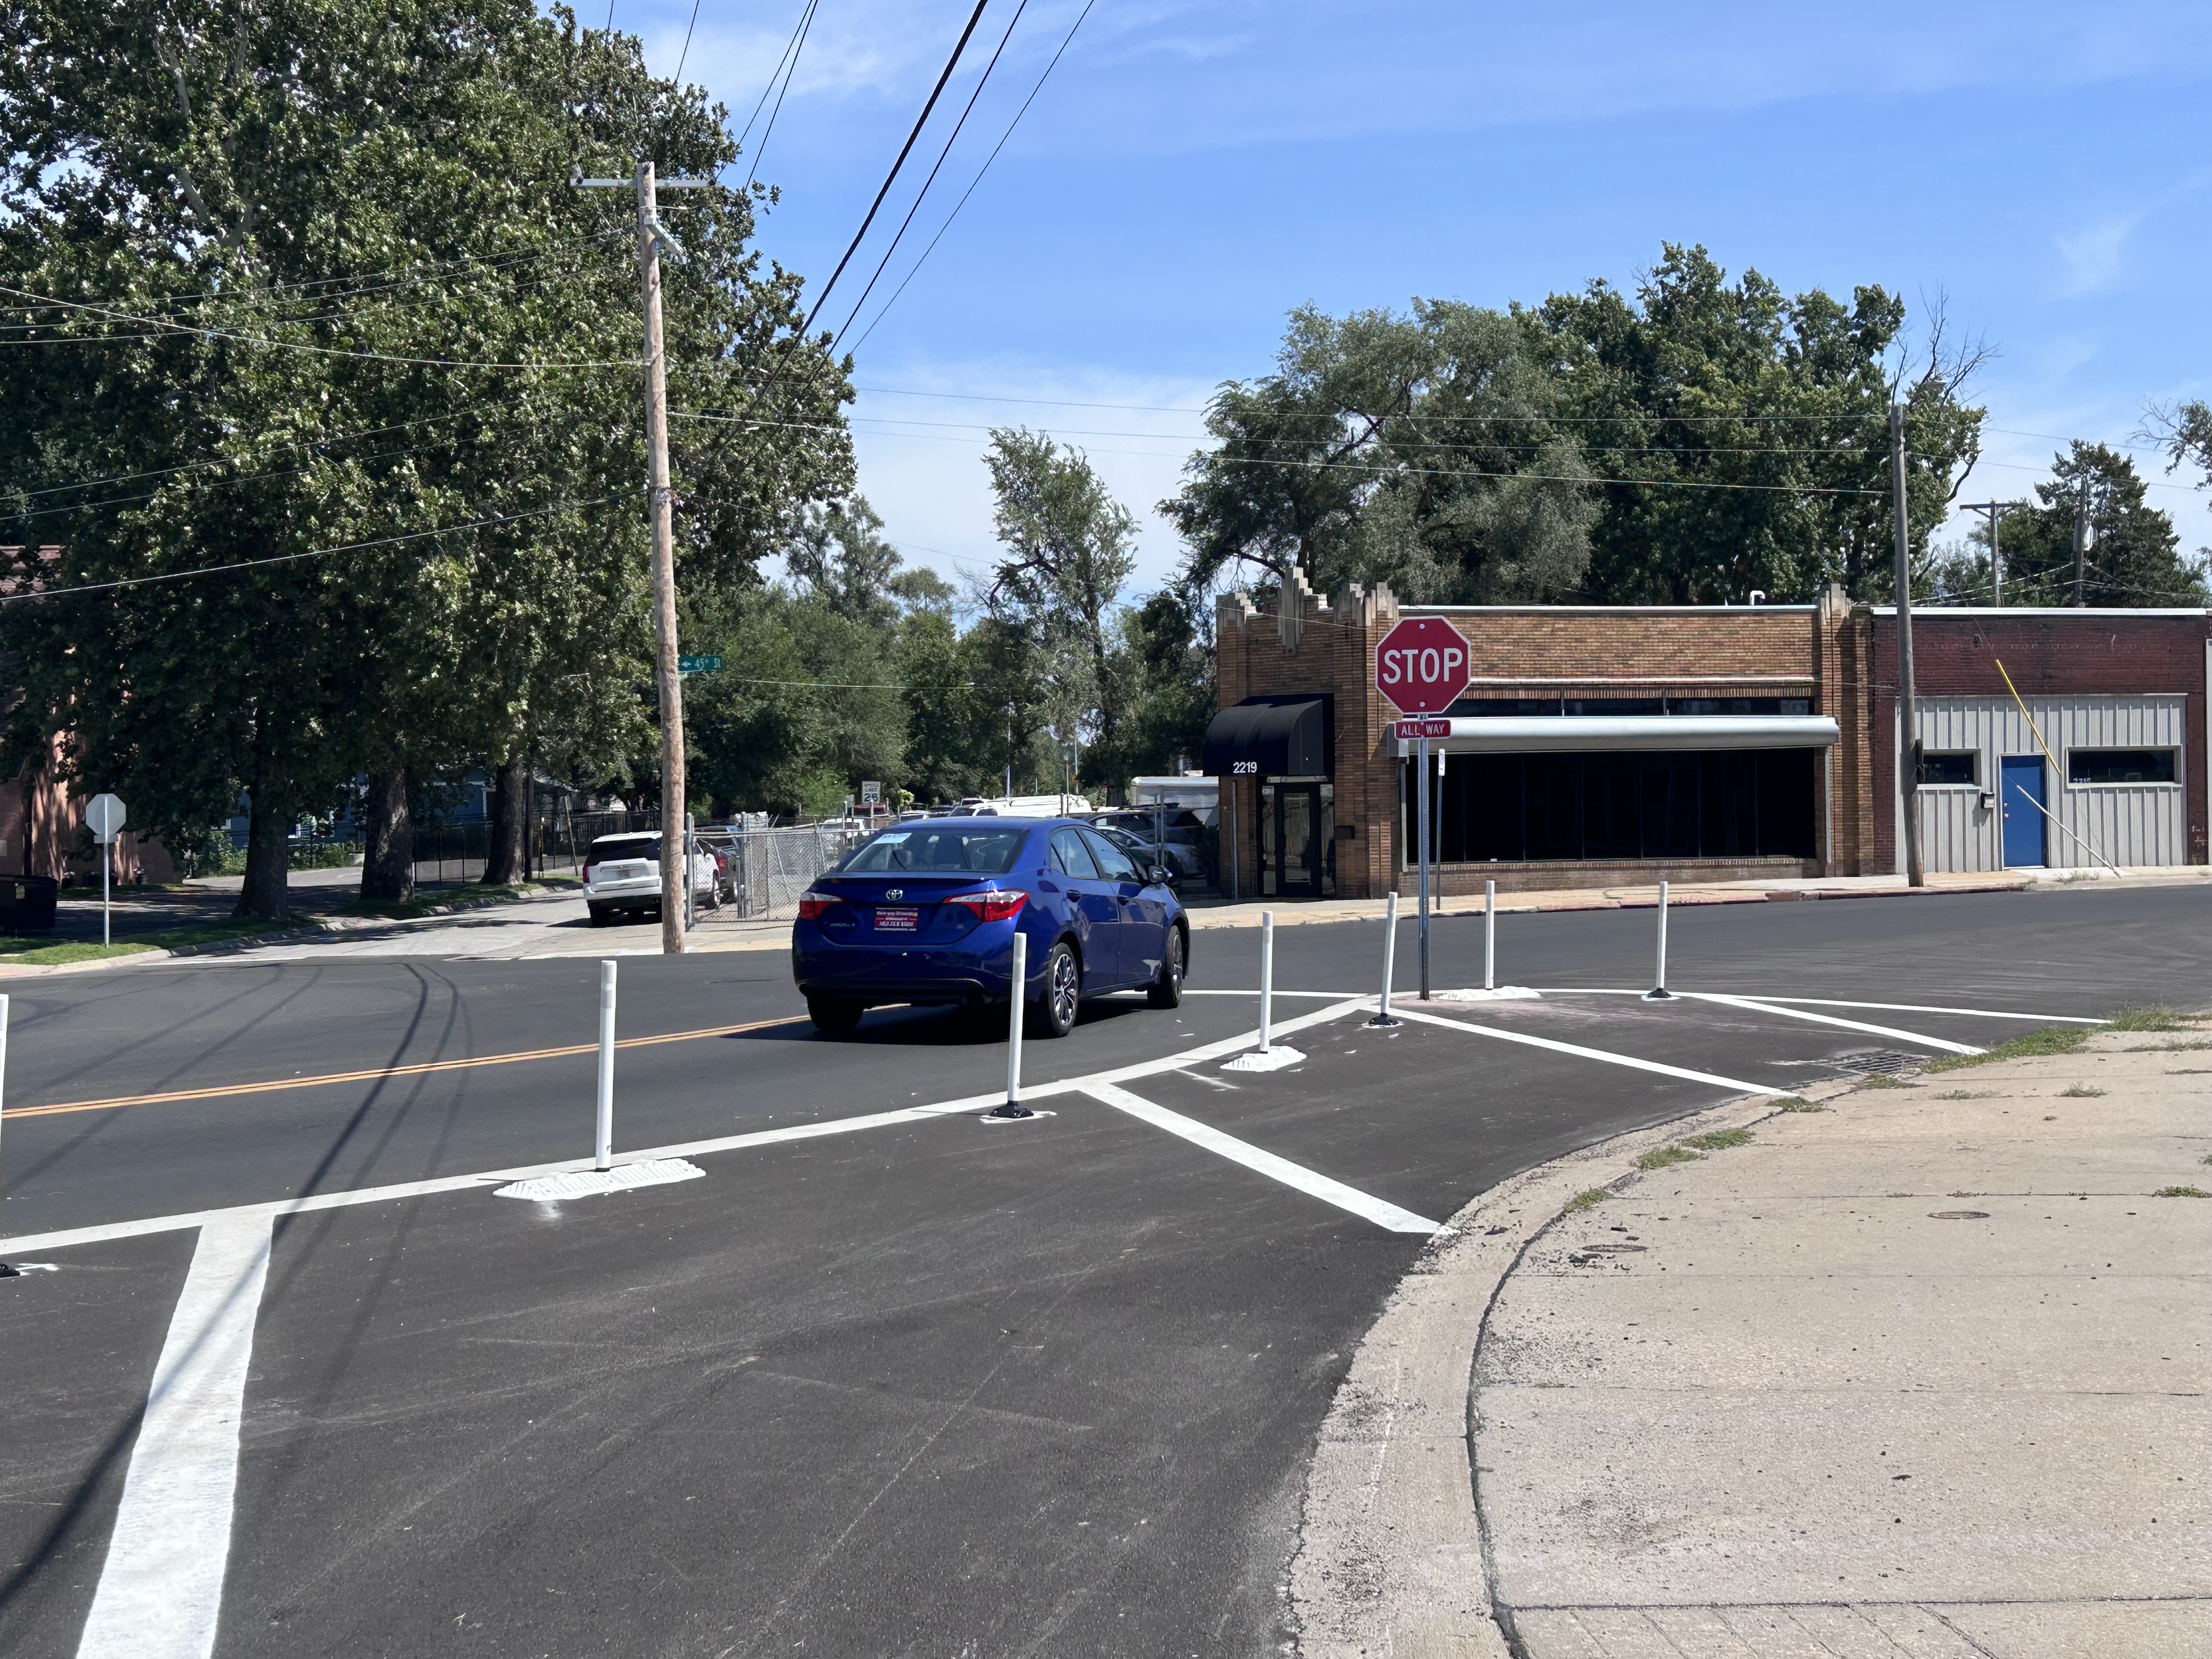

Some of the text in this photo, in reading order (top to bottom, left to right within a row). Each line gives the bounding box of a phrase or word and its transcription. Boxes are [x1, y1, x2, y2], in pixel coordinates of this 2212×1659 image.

[1383, 648, 1463, 684] STOP
[1401, 723, 1444, 736] ALL WAY
[1233, 761, 1257, 774] 2219
[864, 793, 879, 802] 25
